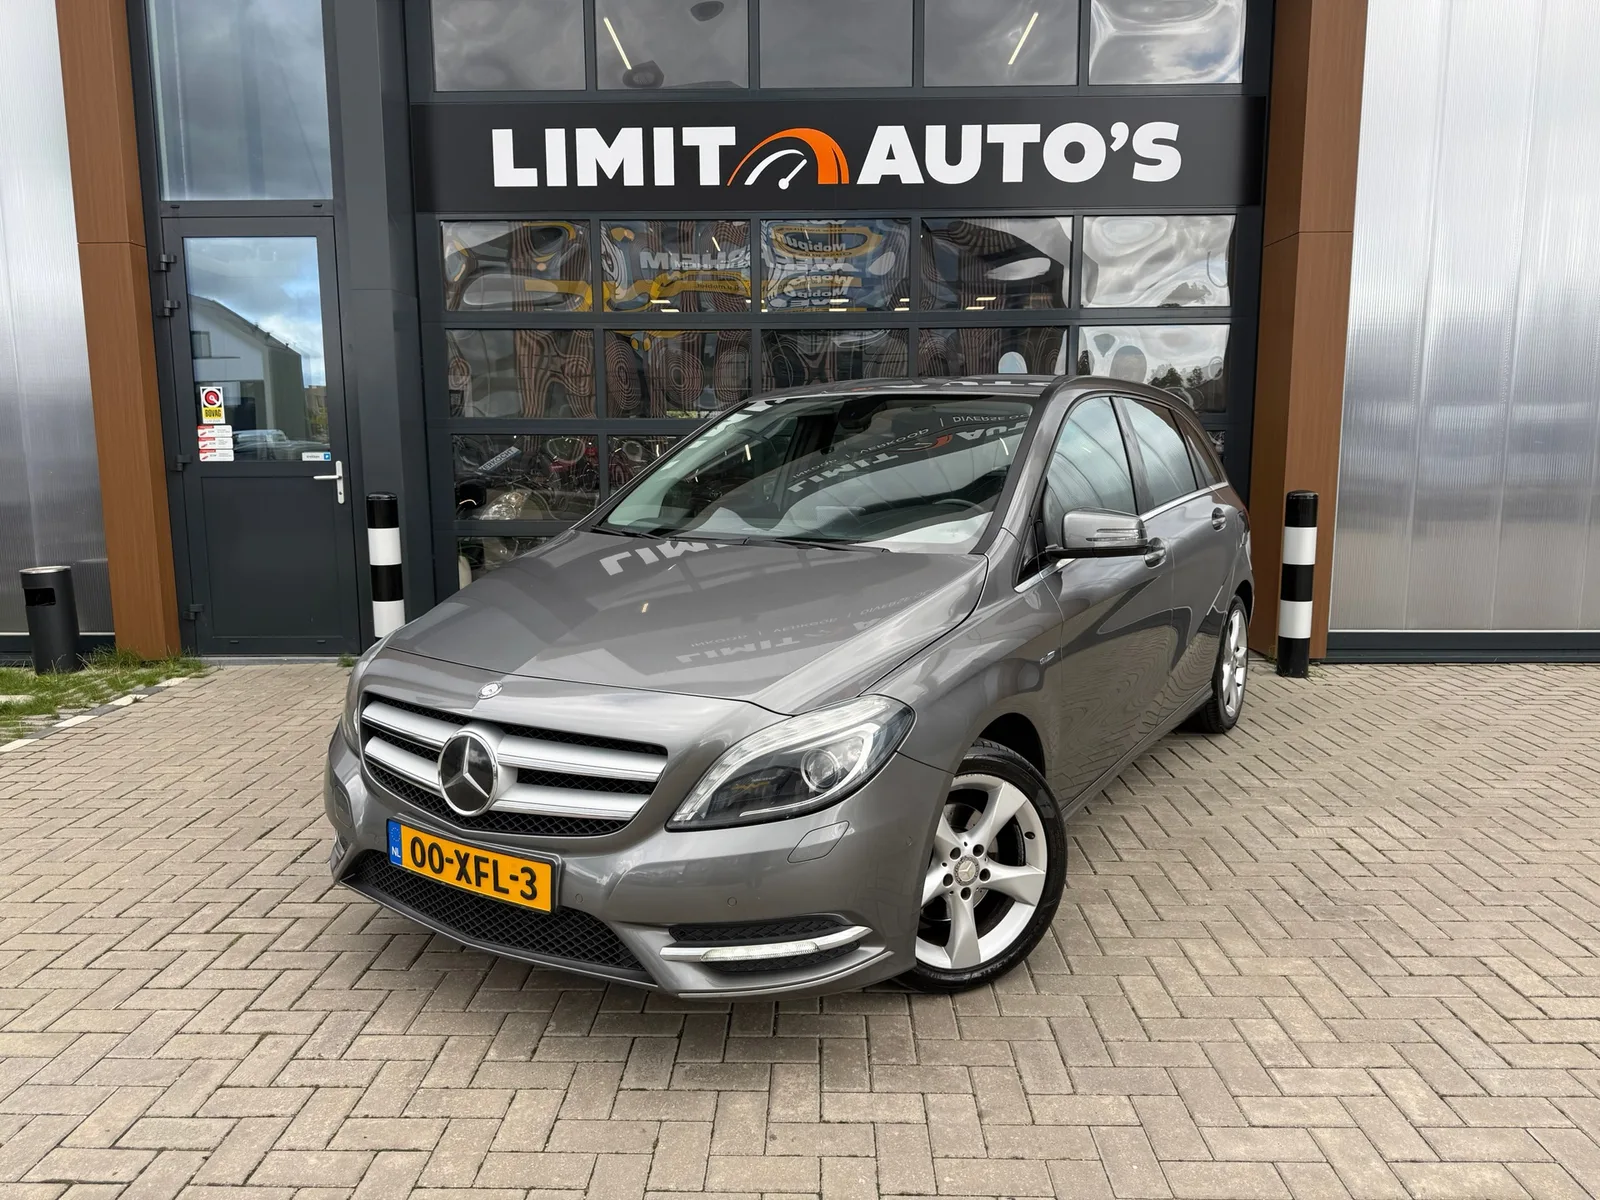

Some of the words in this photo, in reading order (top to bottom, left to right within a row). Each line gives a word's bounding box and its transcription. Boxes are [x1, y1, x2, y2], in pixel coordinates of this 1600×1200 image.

[492, 126, 736, 189] LIMIT
[858, 121, 1182, 188] AUTO'S
[205, 409, 222, 418] BOVAG
[391, 845, 401, 858] NL
[410, 836, 538, 901] 00-XFL-3
